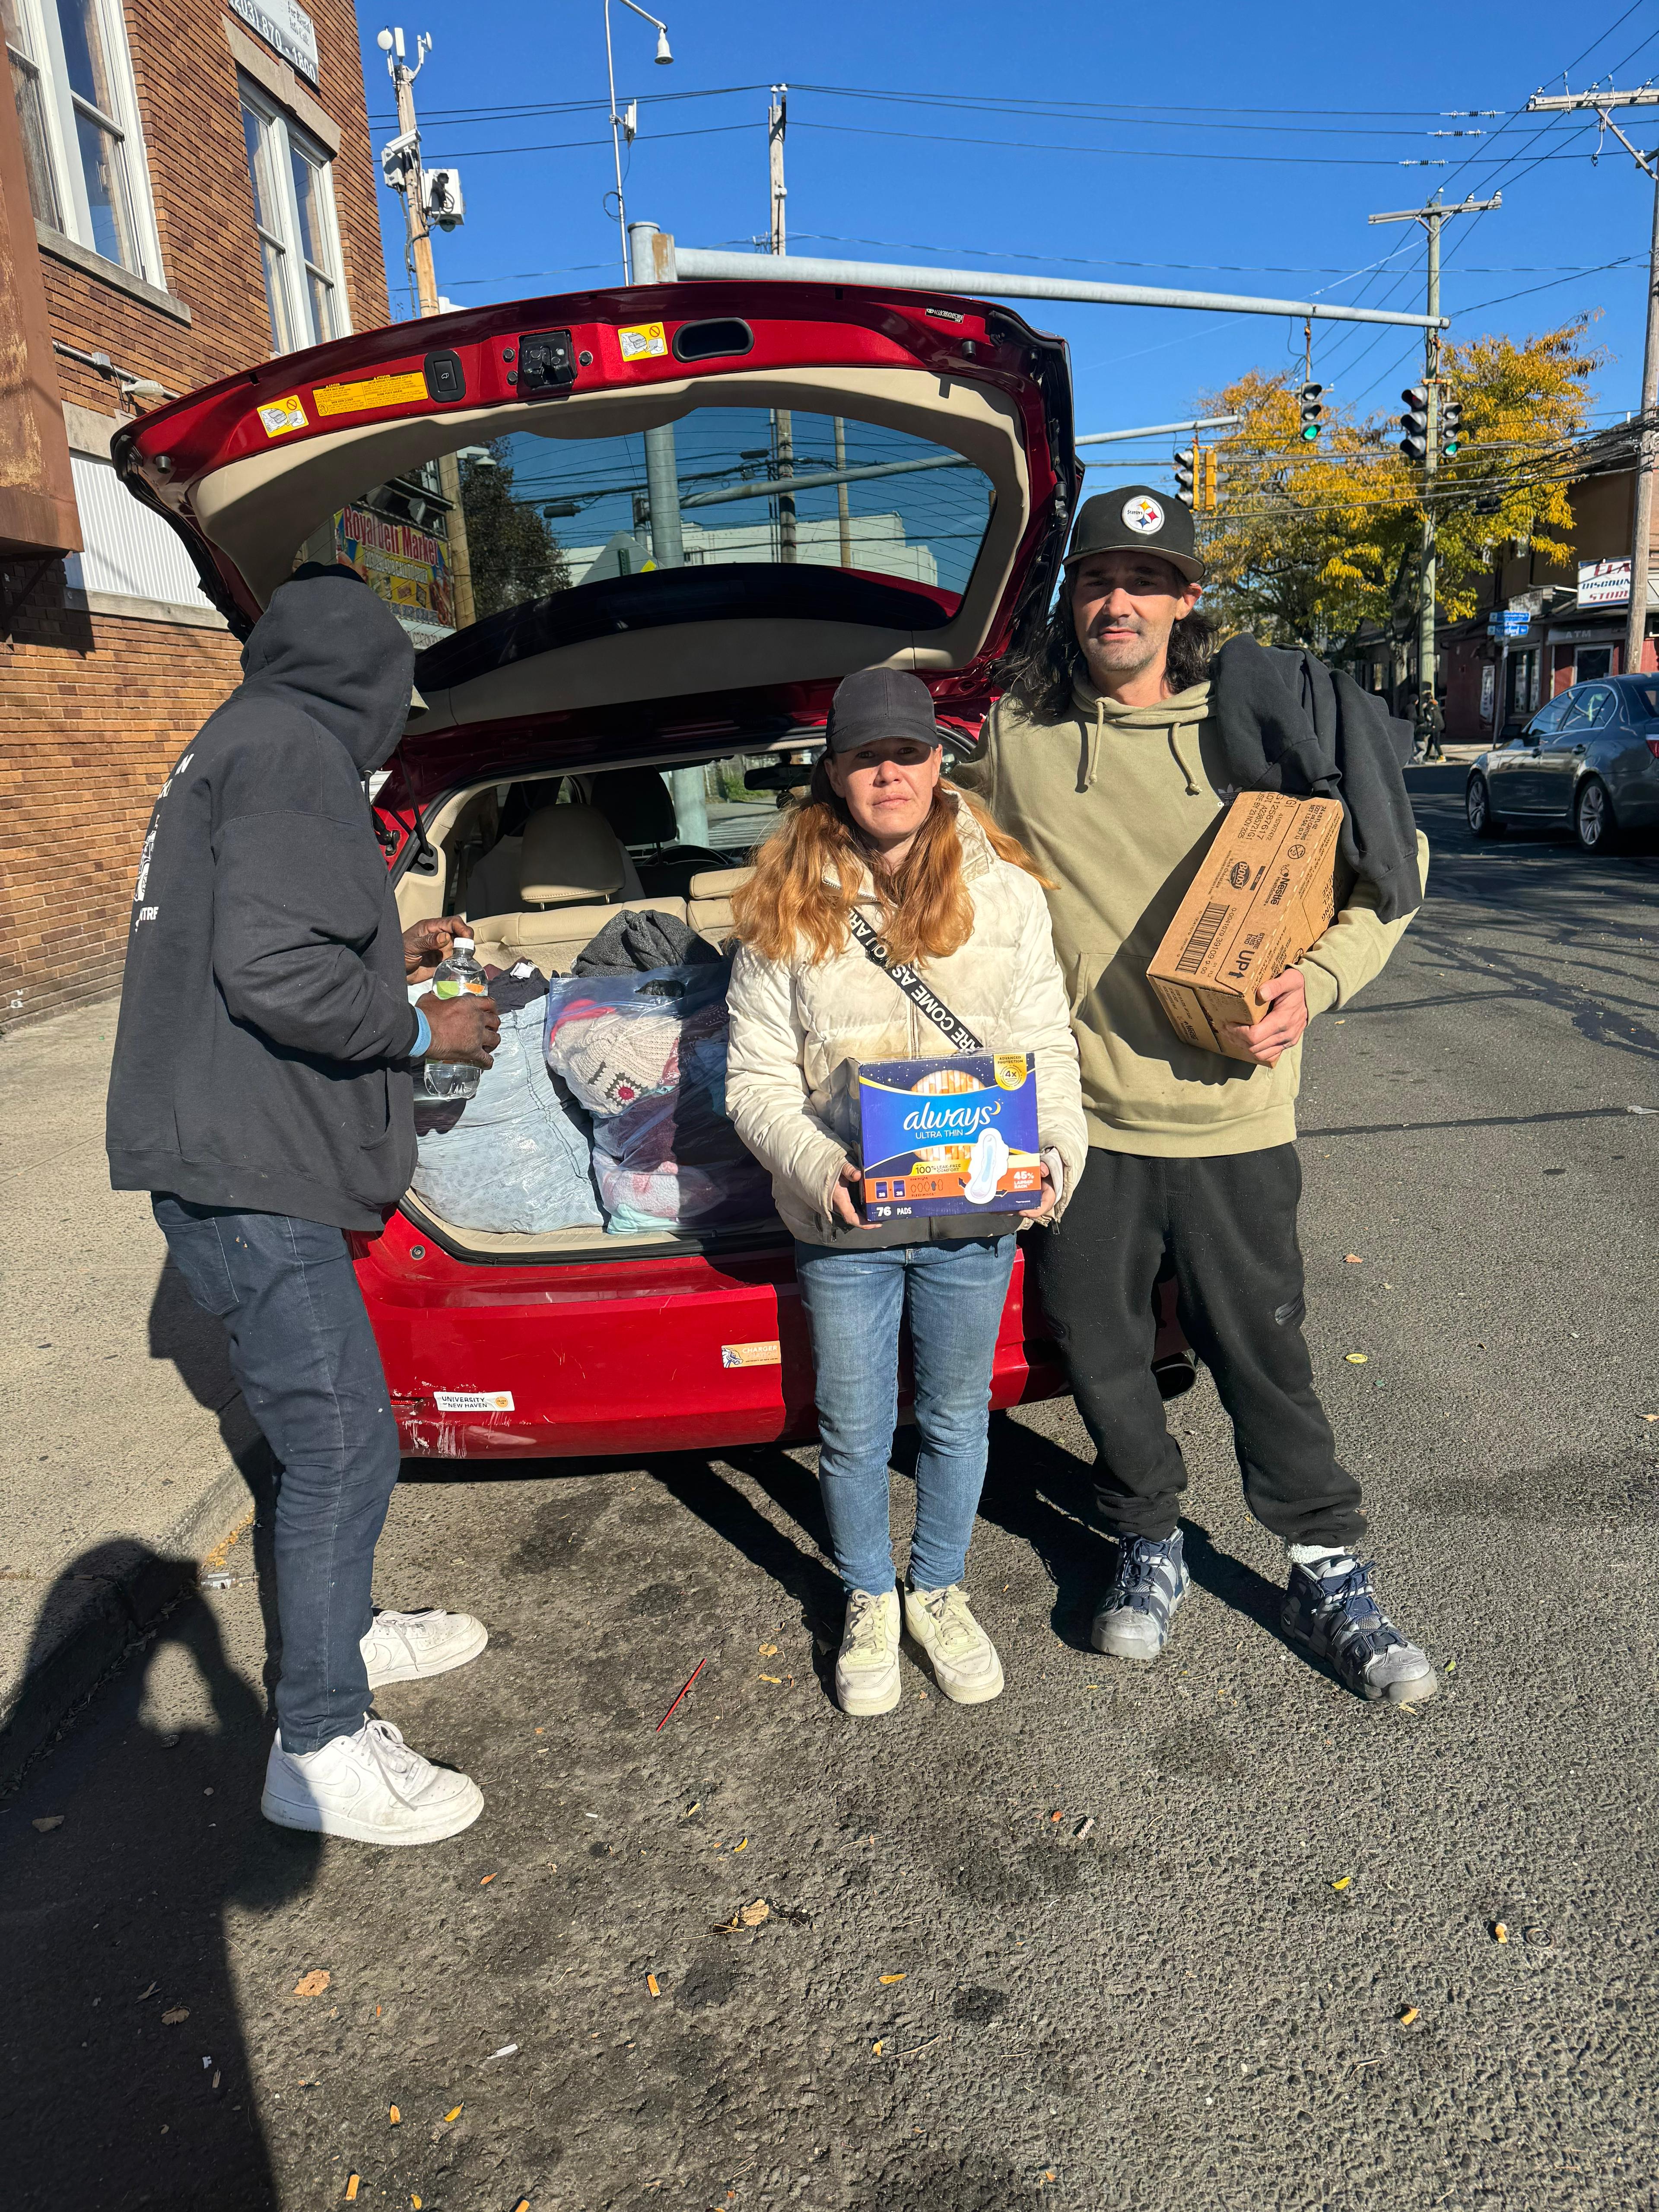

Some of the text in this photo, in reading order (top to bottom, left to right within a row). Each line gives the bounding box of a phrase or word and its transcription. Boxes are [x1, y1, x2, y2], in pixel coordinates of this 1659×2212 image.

[261, 16, 282, 49] 870
[292, 47, 316, 83] 1800
[343, 505, 376, 547] Royal
[401, 525, 439, 567] Market
[1582, 579, 1630, 589] DISCOUN
[1565, 629, 1592, 639] ATM
[1244, 816, 1253, 826] NOV
[1237, 827, 1247, 838] 2025
[1235, 863, 1247, 888] BOOST
[1243, 934, 1252, 944] END
[1249, 934, 1258, 946] THIS
[1252, 933, 1265, 949] STORE
[865, 936, 887, 958] OU
[1207, 937, 1223, 959] 39109
[1235, 950, 1255, 971] UP
[892, 965, 917, 986] AS
[911, 985, 954, 1030] COME
[903, 1102, 992, 1135] always
[915, 1129, 963, 1139] ULTRA THIN
[1014, 1171, 1034, 1180] 45%
[876, 1206, 912, 1217] 76 PADS
[742, 1345, 777, 1354] CHARGER
